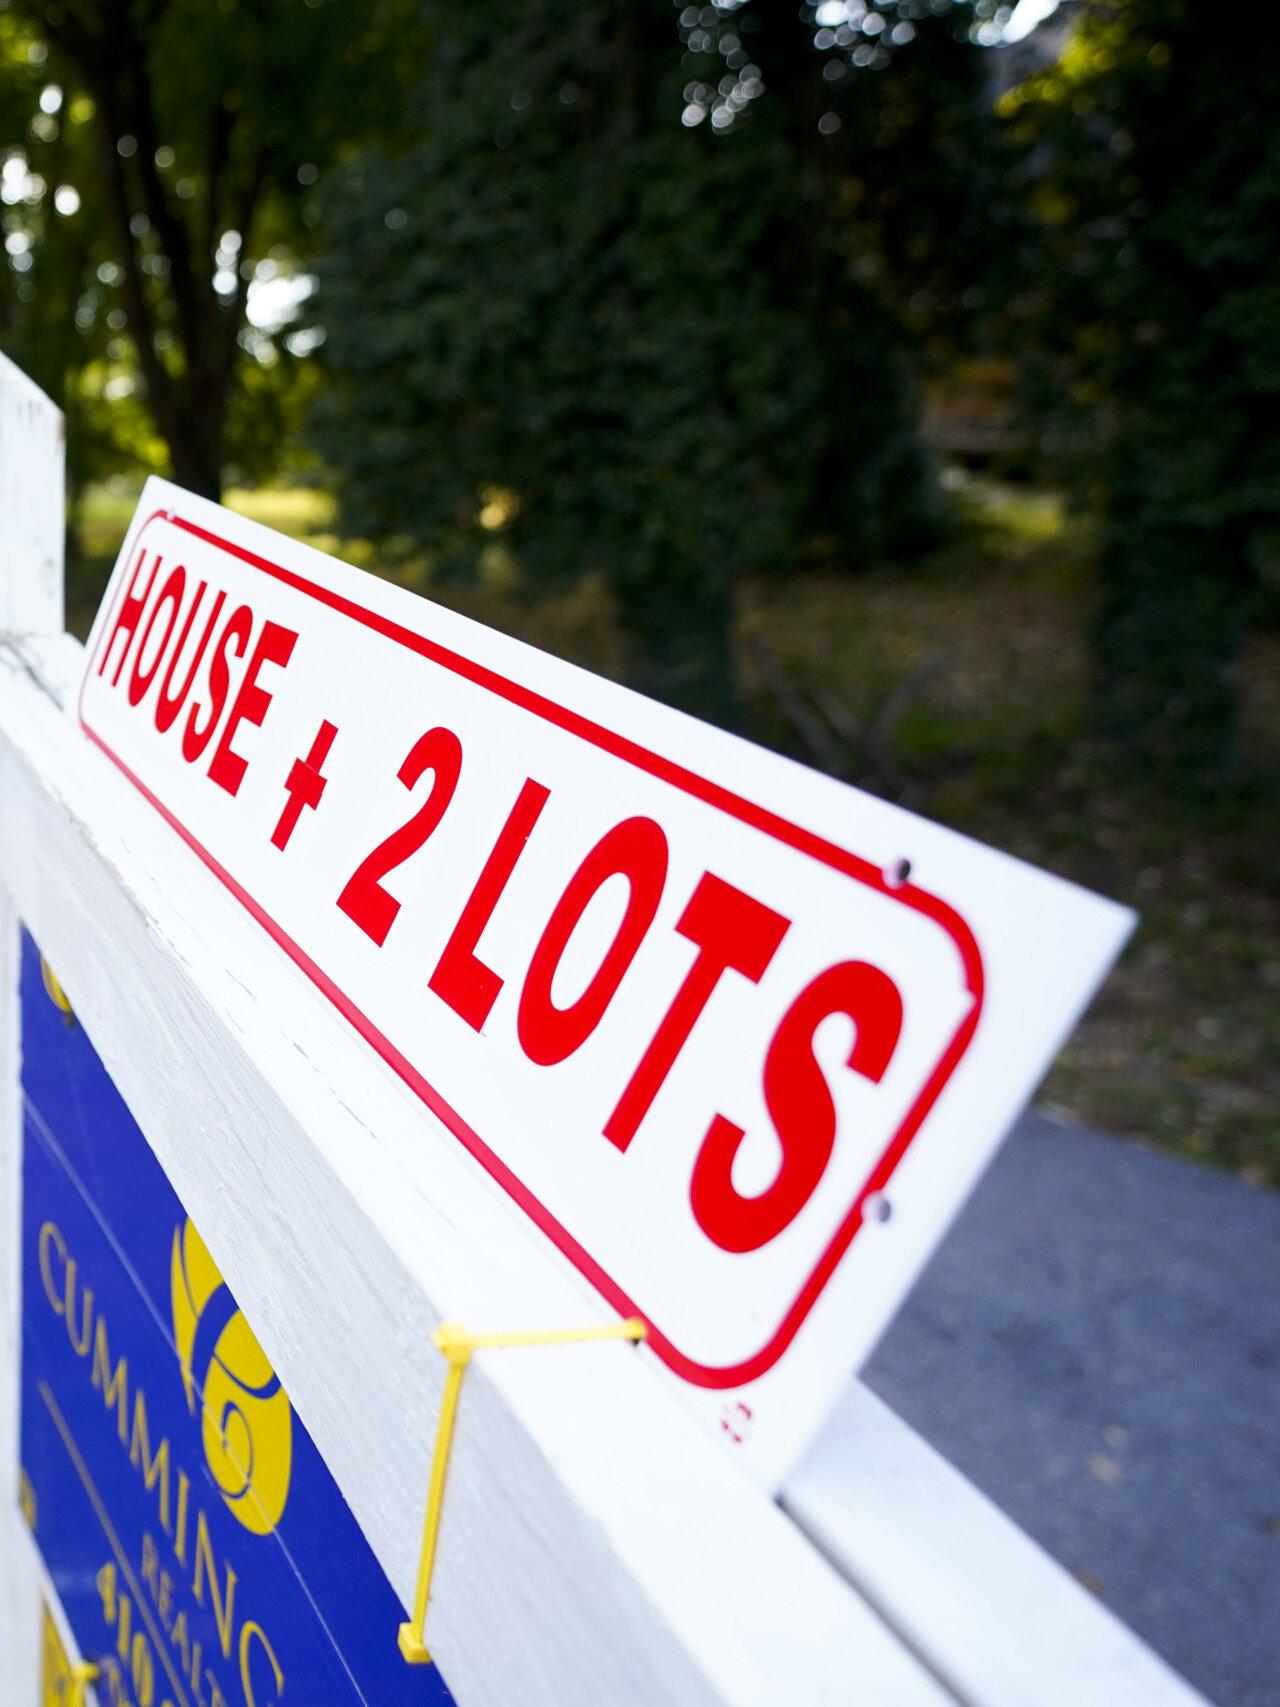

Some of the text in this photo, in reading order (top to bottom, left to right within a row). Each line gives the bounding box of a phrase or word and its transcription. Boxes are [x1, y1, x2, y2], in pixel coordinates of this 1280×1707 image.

[98, 549, 904, 1255] HOUSE + 2 LOTS
